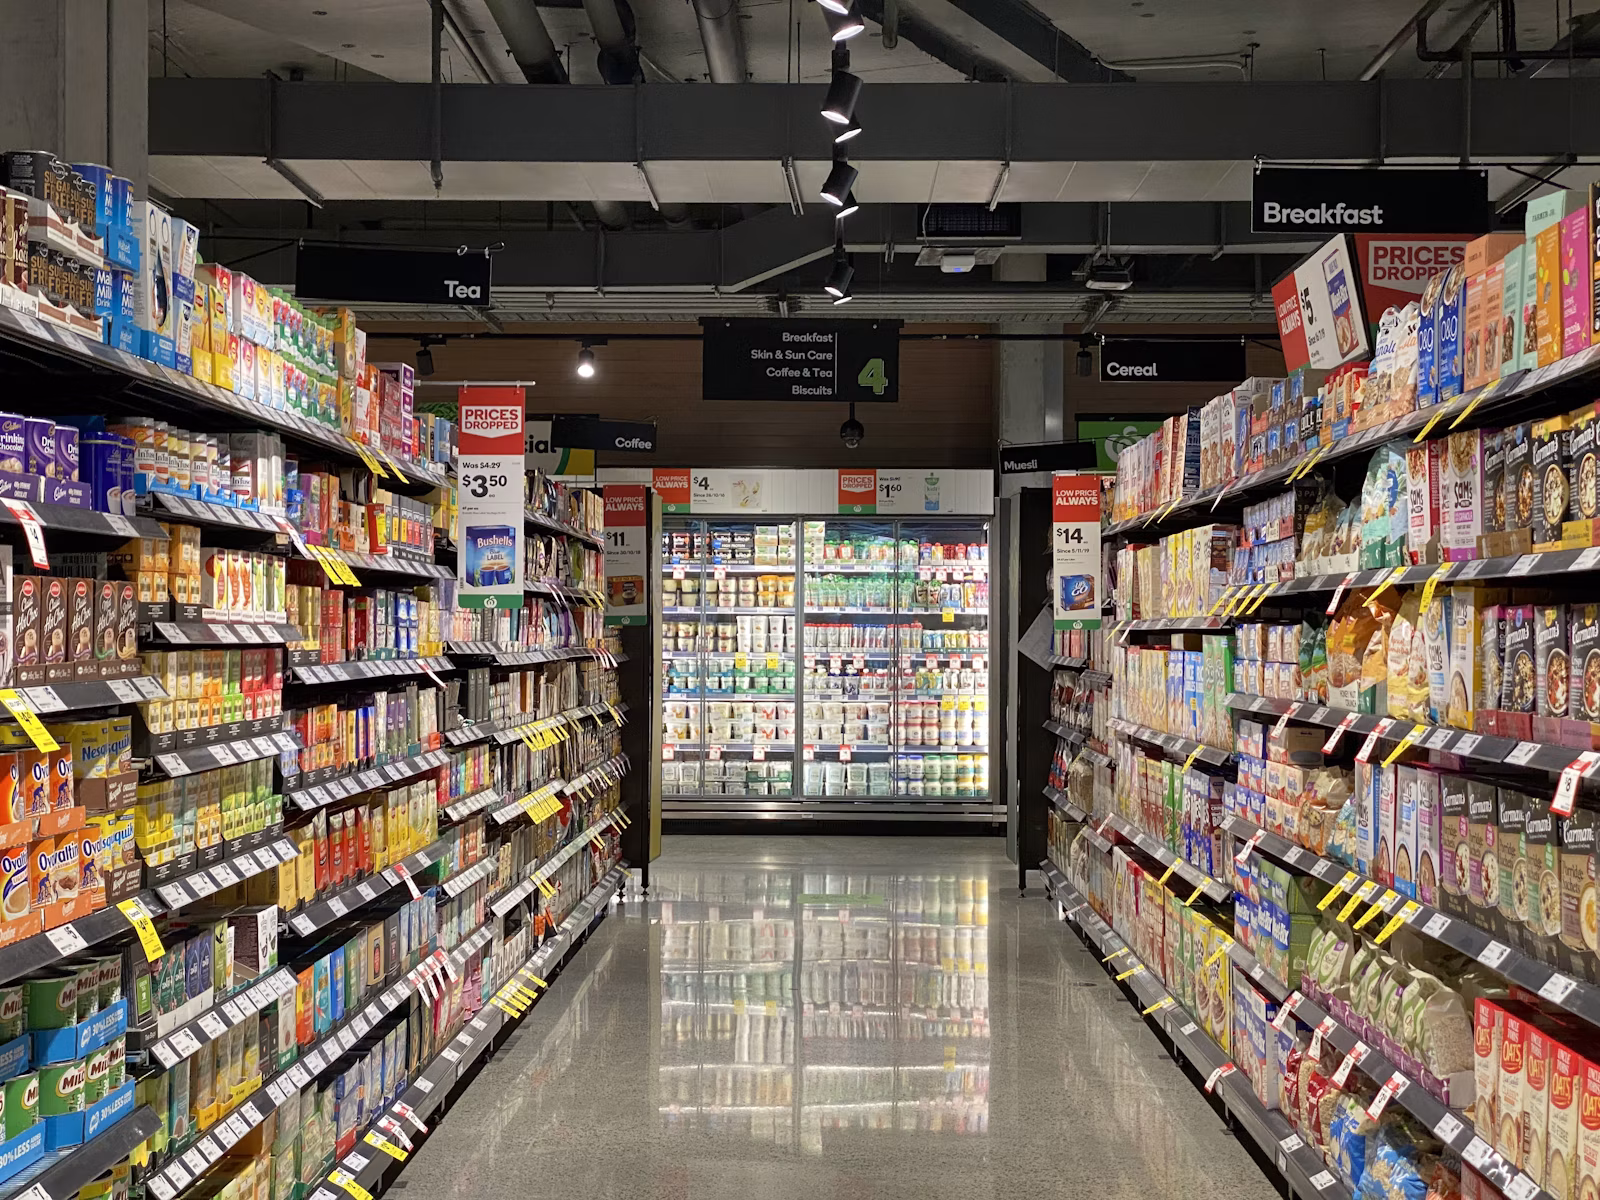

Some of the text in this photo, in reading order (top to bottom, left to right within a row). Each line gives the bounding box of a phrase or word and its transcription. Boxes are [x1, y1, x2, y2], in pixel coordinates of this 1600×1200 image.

[1263, 202, 1383, 224] Breakfast
[1373, 246, 1464, 265] PRICES
[1373, 266, 1446, 281] DROPP
[444, 280, 481, 298] Tea
[1301, 287, 1314, 325] $5
[1281, 310, 1301, 336] ALWAYS
[782, 332, 833, 342] Breakfast
[751, 350, 833, 361] Skin & Sun Care
[766, 367, 833, 378] Coffee & Tea
[1107, 362, 1158, 376] Cereal
[858, 358, 888, 395] 4
[792, 385, 833, 395] Biscuits
[465, 409, 518, 420] PRICES
[464, 421, 519, 430] DROPPED
[615, 437, 652, 449] Coffee
[1004, 459, 1038, 471] Muesli
[693, 476, 709, 490] $4
[606, 502, 644, 511] ALWAYS
[1056, 497, 1098, 505] ALWAYS
[477, 535, 513, 548] Bushells
[607, 532, 625, 546] $11
[1056, 528, 1083, 544] $14
[1072, 588, 1088, 596] GO
[1503, 1040, 1521, 1062] OATS
[1529, 1055, 1544, 1080] OATS
[1553, 1072, 1571, 1097] OATS
[101, 1100, 124, 1122] 30% LESS
[14, 1140, 31, 1160] LESS
